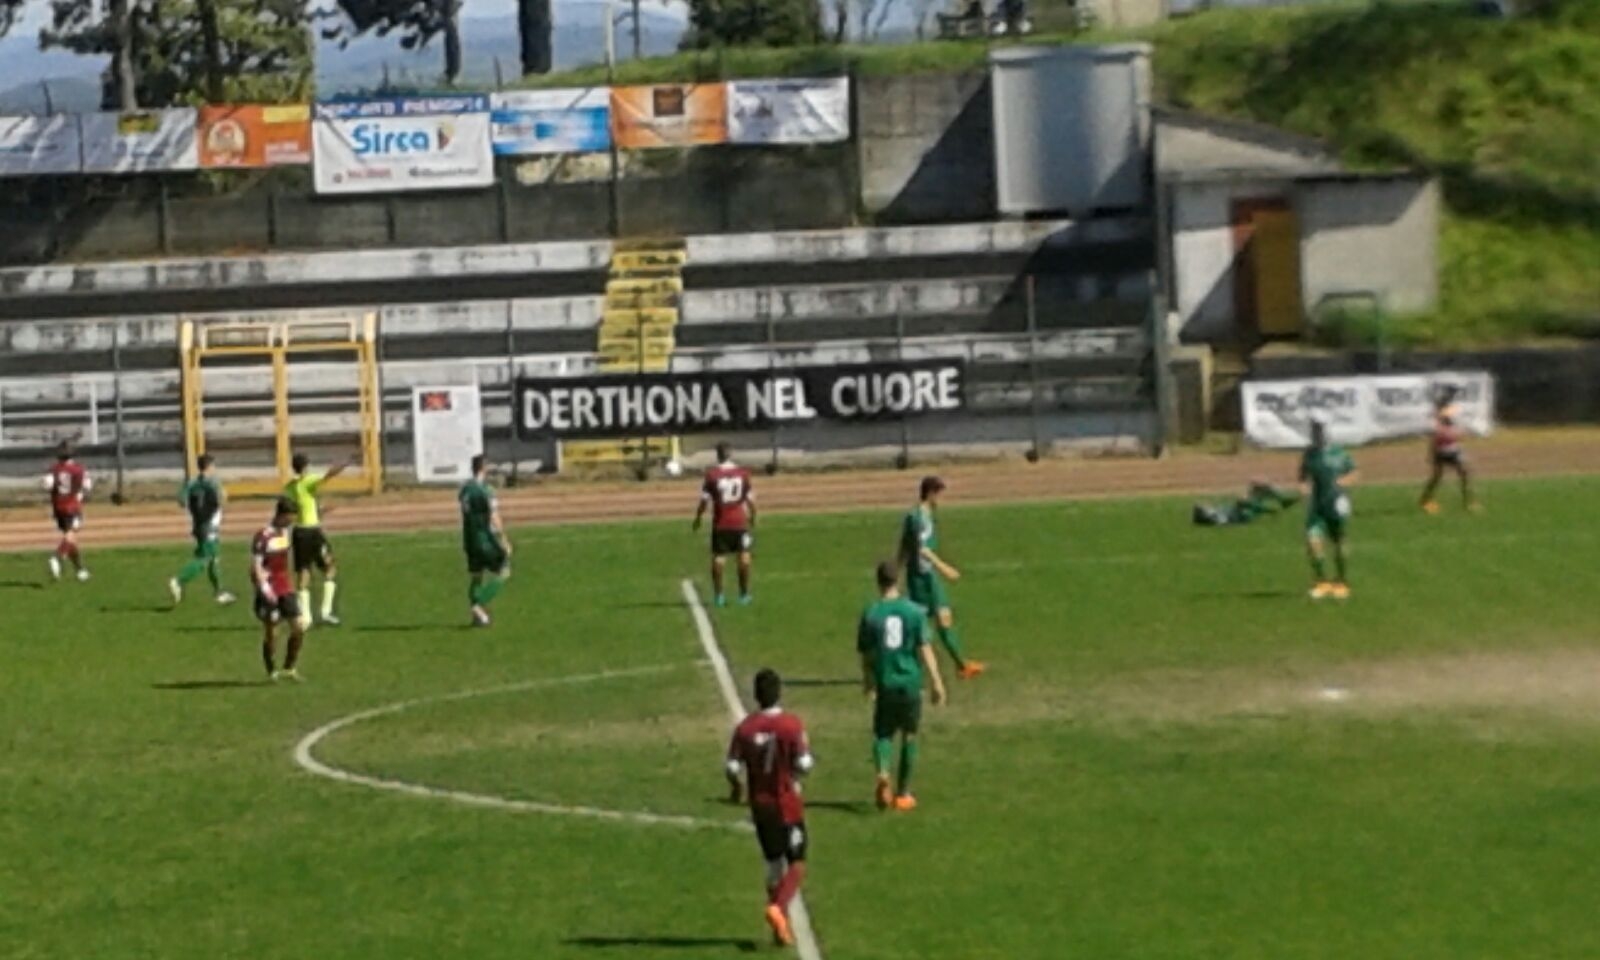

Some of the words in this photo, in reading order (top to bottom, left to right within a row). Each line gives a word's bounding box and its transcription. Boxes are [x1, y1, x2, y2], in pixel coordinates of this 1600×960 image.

[352, 123, 430, 154] Sirca
[523, 383, 731, 429] DERTHONA
[746, 377, 818, 422] NEL
[831, 366, 961, 416] CUORE
[754, 731, 777, 775] 7
